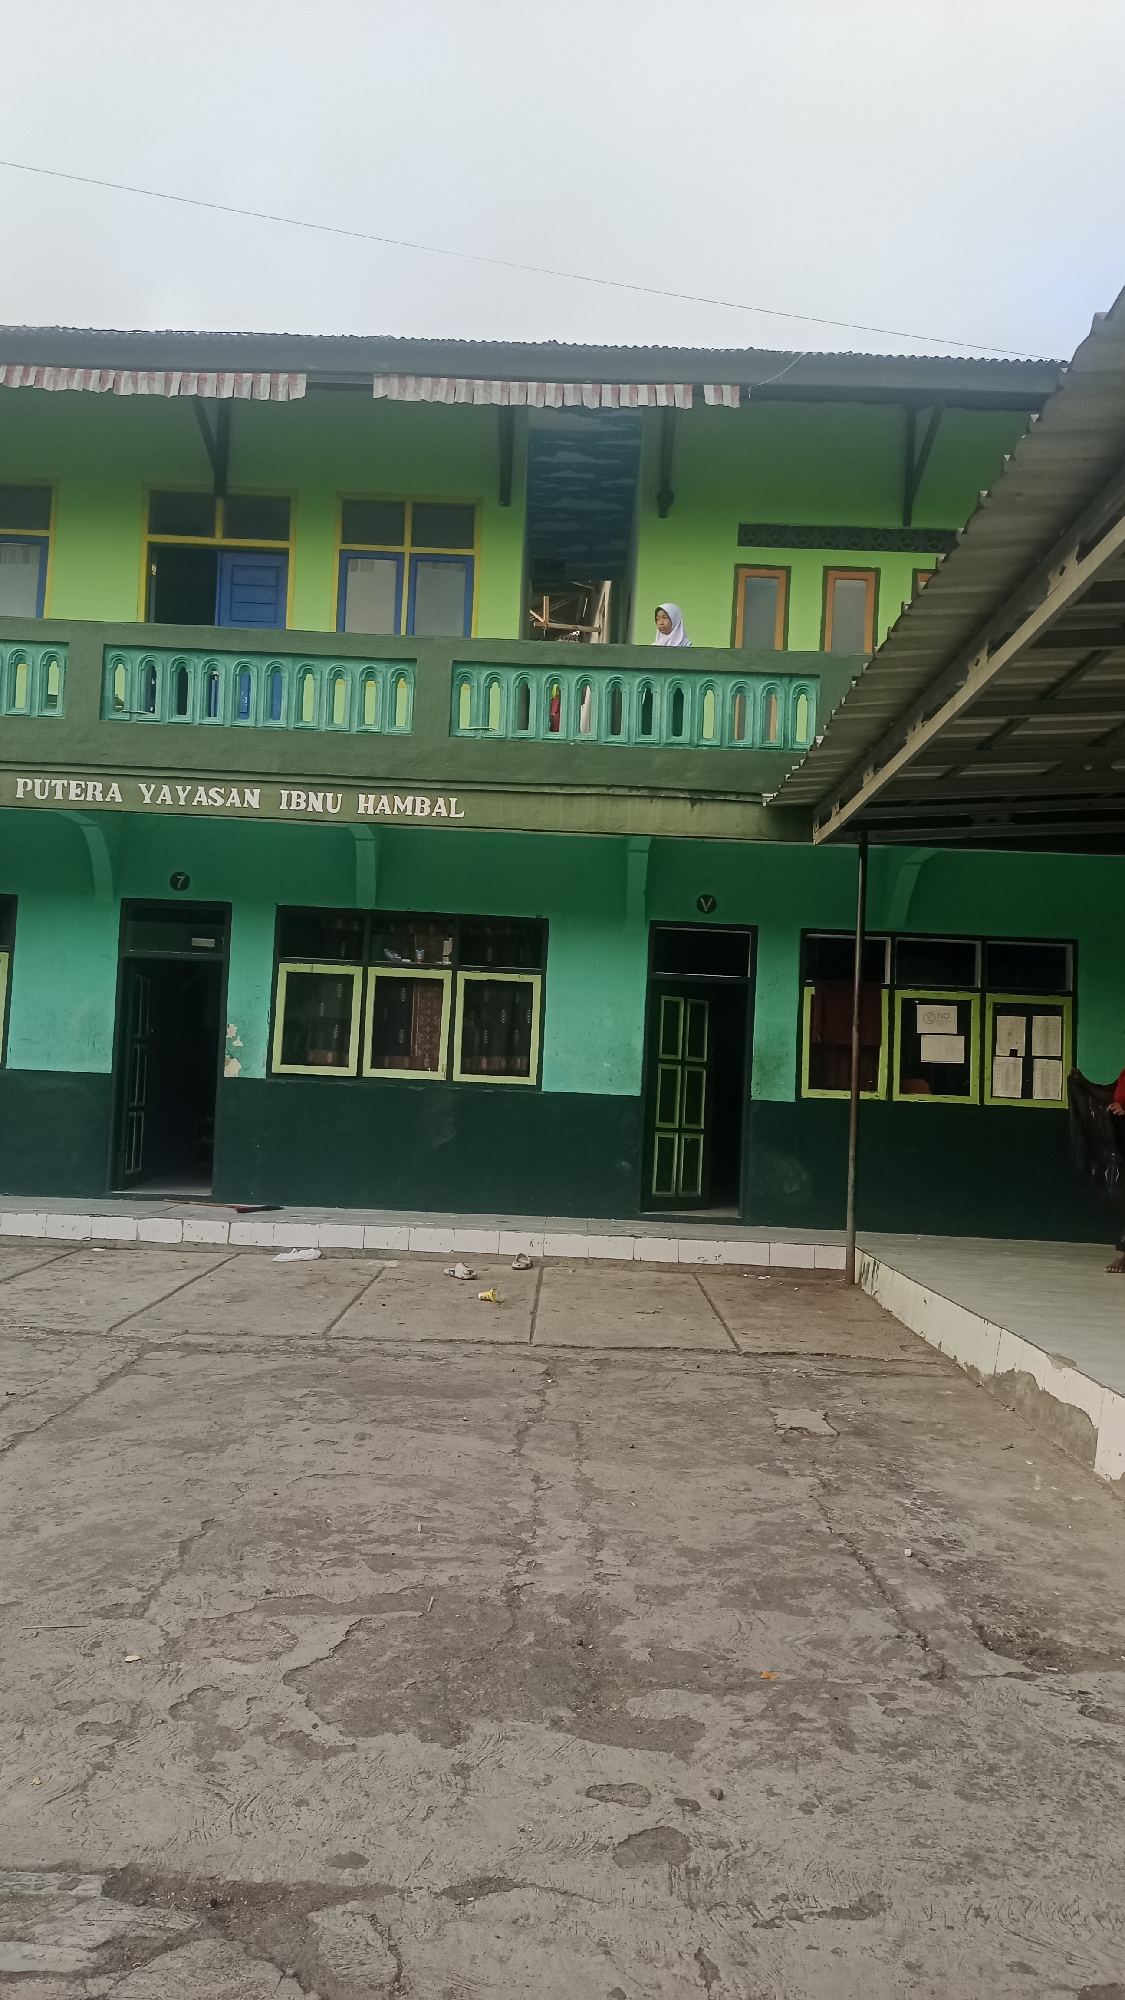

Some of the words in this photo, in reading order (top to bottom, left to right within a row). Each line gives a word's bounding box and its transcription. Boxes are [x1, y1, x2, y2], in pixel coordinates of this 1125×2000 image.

[15, 777, 123, 803] PUTERA
[138, 783, 261, 809] YAYASAN
[279, 789, 343, 814] IBNU
[357, 794, 466, 818] HAMBAL
[176, 875, 186, 889] 7
[700, 897, 713, 912] V
[936, 1012, 950, 1020] NO
